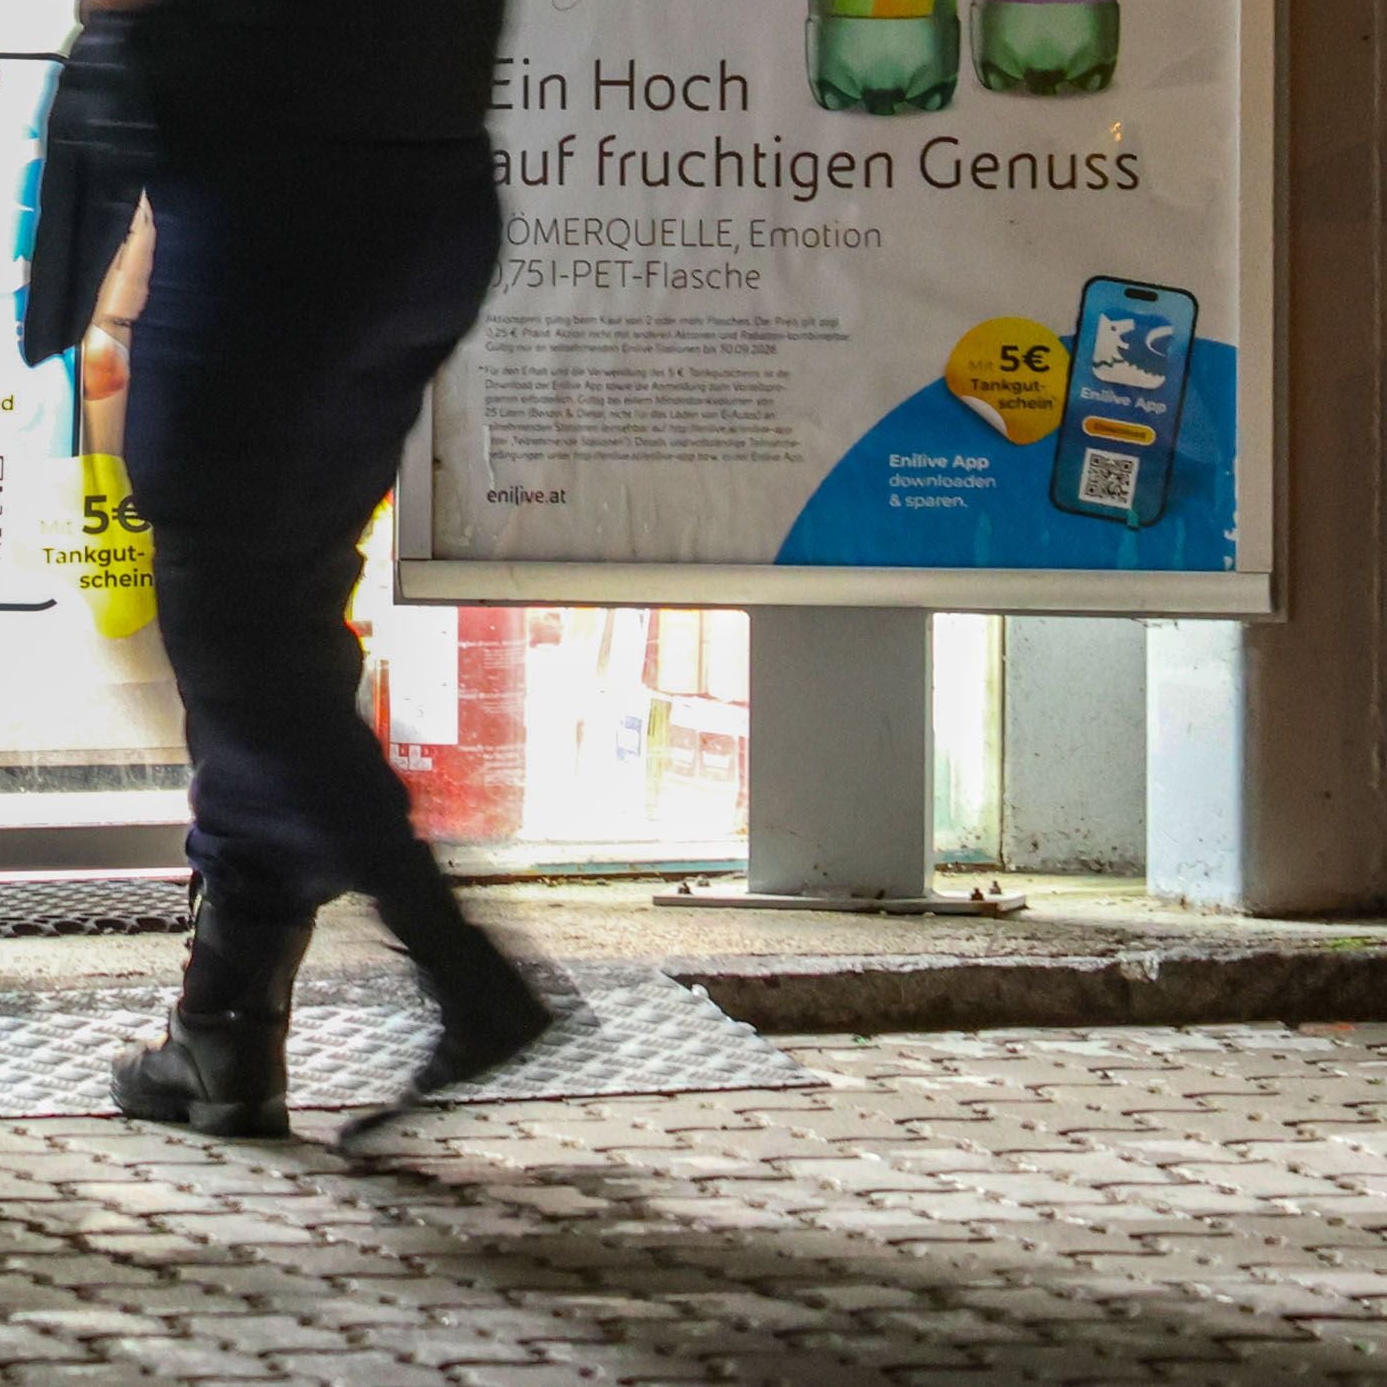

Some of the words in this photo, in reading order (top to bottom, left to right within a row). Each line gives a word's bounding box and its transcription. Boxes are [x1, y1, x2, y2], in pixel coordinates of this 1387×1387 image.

[490, 57, 567, 111] Ein
[595, 58, 749, 111] Hoch
[492, 134, 577, 187] auf
[598, 134, 894, 202] fruchtigen
[919, 137, 1141, 191] Genuss
[505, 212, 740, 253] ÖMERQUELLE,
[749, 217, 882, 249] Emotion
[999, 345, 1051, 373] 5€
[970, 378, 1047, 395] Tankgut-
[1080, 387, 1131, 406] Enilive
[1134, 394, 1167, 414] App
[889, 454, 947, 468] Enilive
[953, 455, 990, 470] App
[889, 474, 997, 489] downloaden
[487, 485, 566, 504] enilive.at
[889, 495, 901, 507] &
[906, 495, 968, 510] sparen.
[82, 495, 152, 535] 5€
[42, 545, 145, 567] Tankgut-
[79, 569, 154, 588] schein
